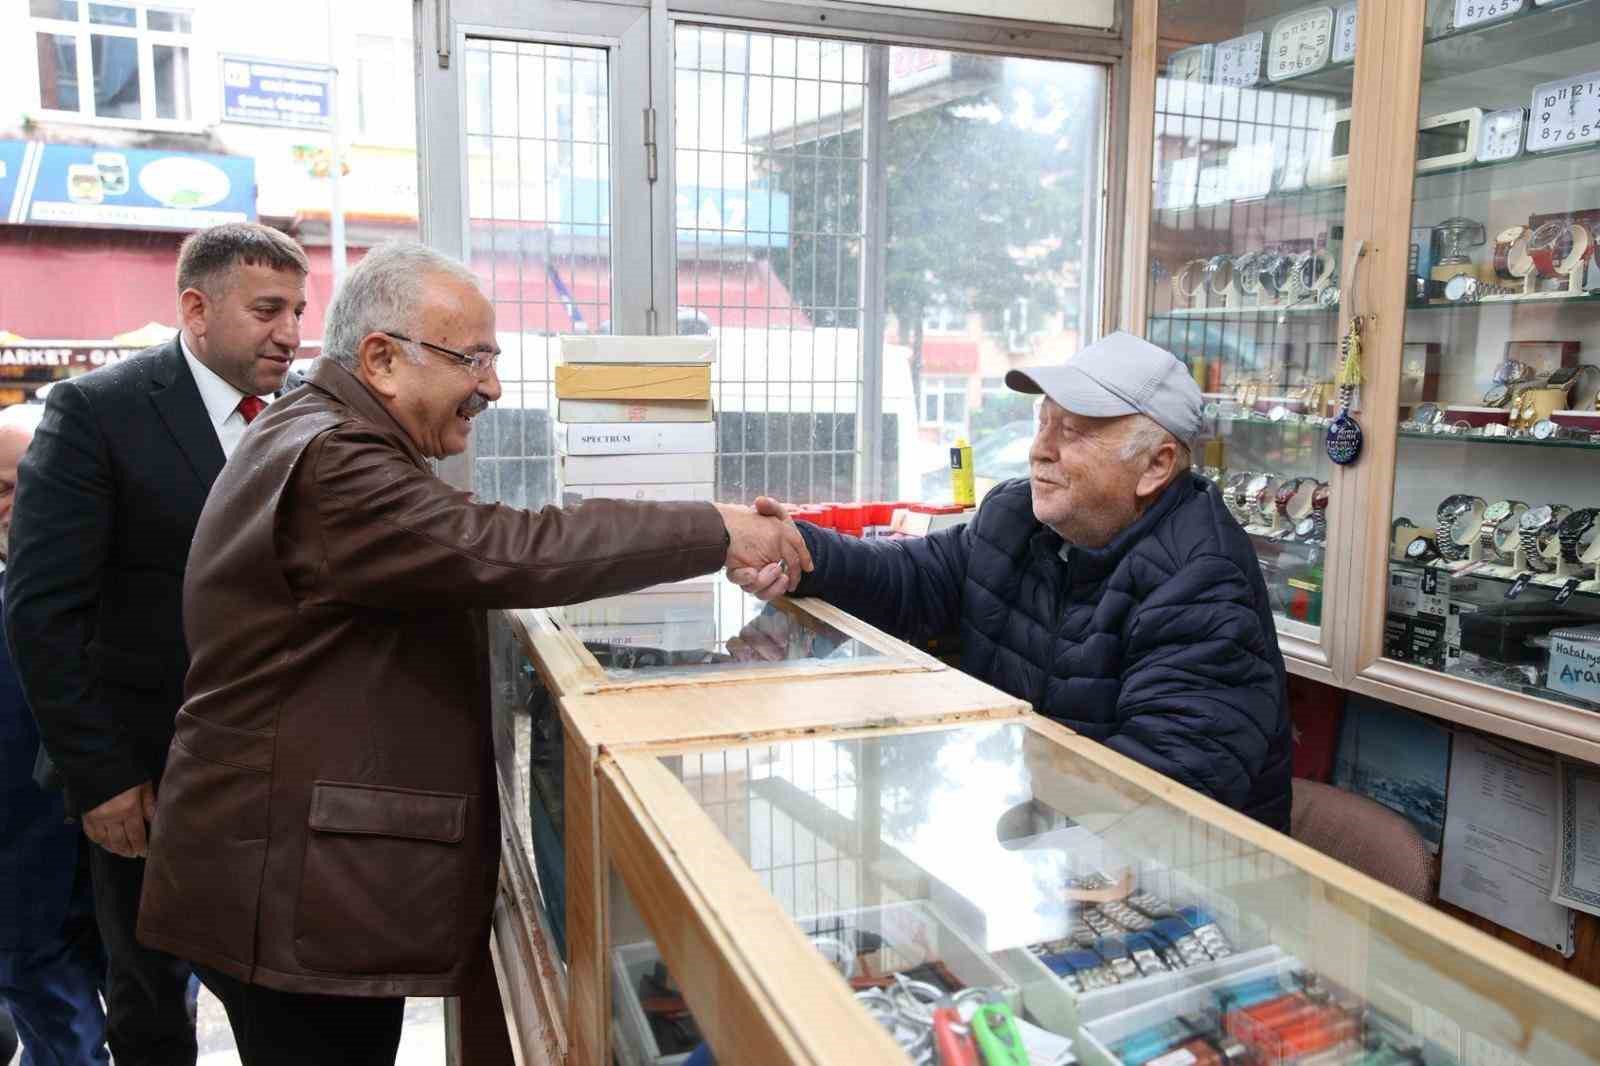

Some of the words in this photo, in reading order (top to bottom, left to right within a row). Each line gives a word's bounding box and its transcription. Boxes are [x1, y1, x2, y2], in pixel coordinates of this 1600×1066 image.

[1467, 6, 1475, 17] 8
[1477, 6, 1485, 18] 7
[1487, 4, 1497, 16] 6
[1558, 88, 1568, 100] 11
[1571, 84, 1584, 96] 12
[1588, 83, 1593, 94] 1
[1543, 95, 1557, 108] 10
[1542, 111, 1551, 124] 9
[1542, 127, 1551, 139] 8
[1554, 129, 1562, 142] 7
[1566, 128, 1576, 141] 6
[1580, 124, 1591, 137] 5
[0, 349, 72, 366] ARKET
[580, 435, 632, 444] SPECTRUM
[1560, 663, 1600, 684] Ara
